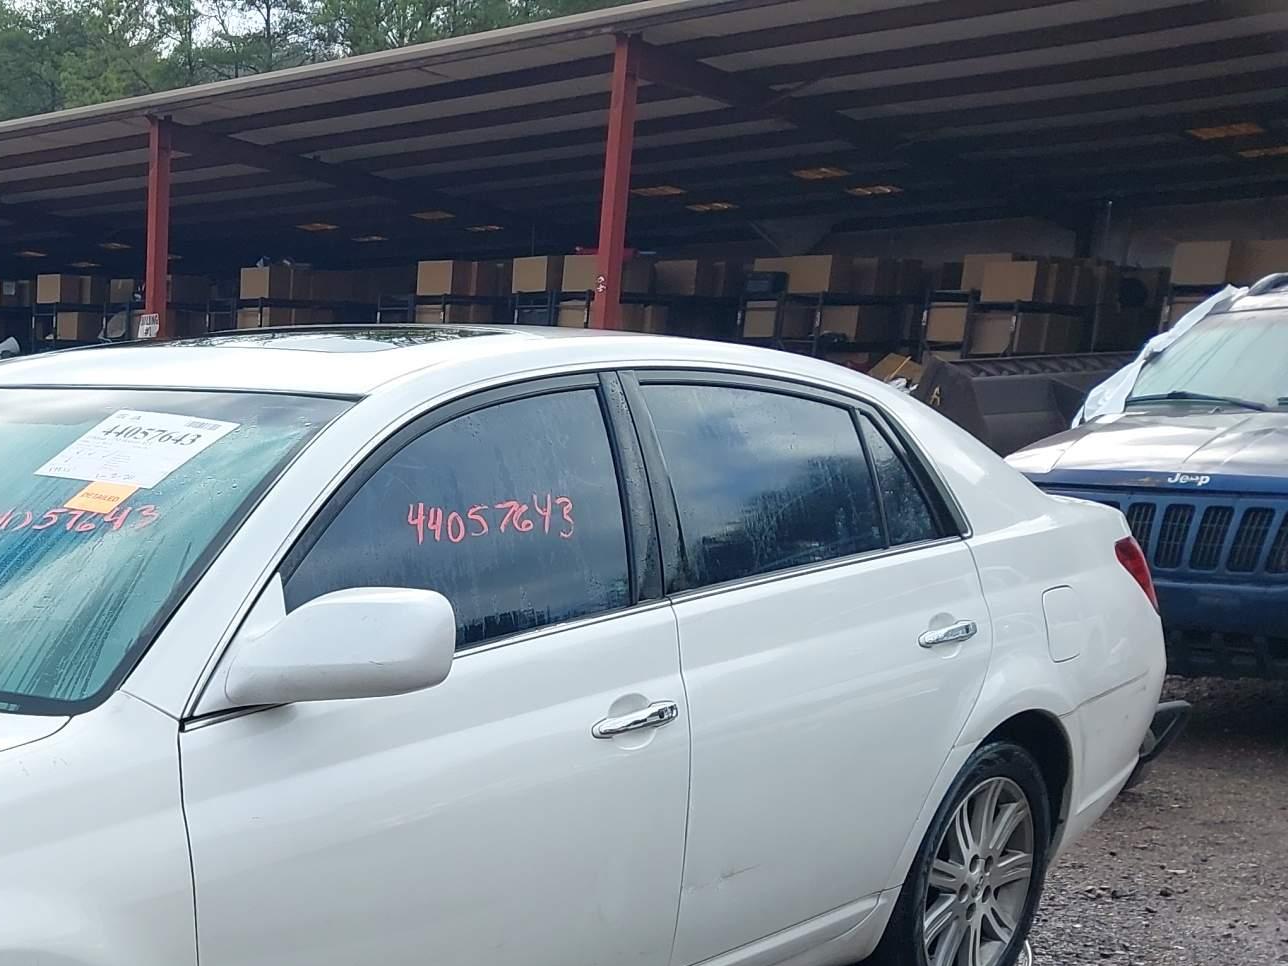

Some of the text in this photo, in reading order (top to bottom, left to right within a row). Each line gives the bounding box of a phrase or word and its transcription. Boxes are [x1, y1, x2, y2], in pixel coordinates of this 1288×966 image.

[101, 423, 203, 446] 44057643
[1167, 472, 1211, 487] Jeep
[407, 492, 575, 545] 44057643
